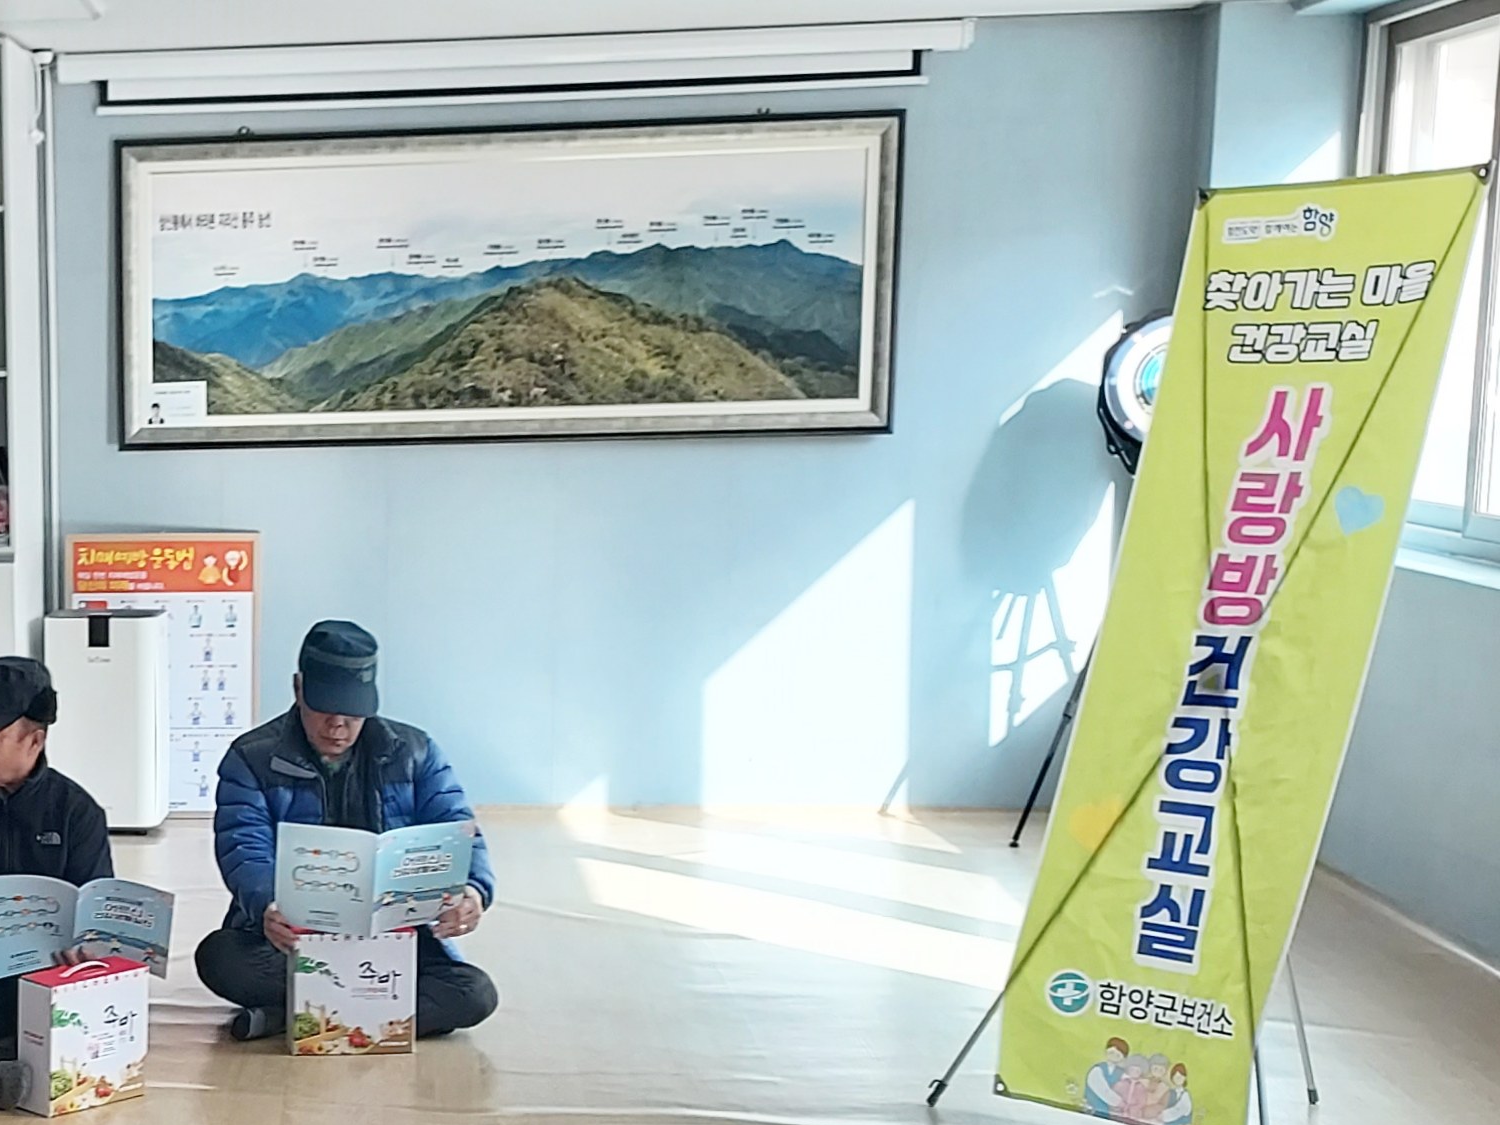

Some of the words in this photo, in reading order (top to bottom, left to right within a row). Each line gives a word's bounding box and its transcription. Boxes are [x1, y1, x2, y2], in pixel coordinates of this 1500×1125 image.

[1302, 206, 1336, 237] 함양
[1203, 268, 1356, 312] 찾아가는
[1361, 260, 1437, 307] 마을
[1226, 319, 1380, 365] 건강교실
[357, 961, 402, 1001] 주방
